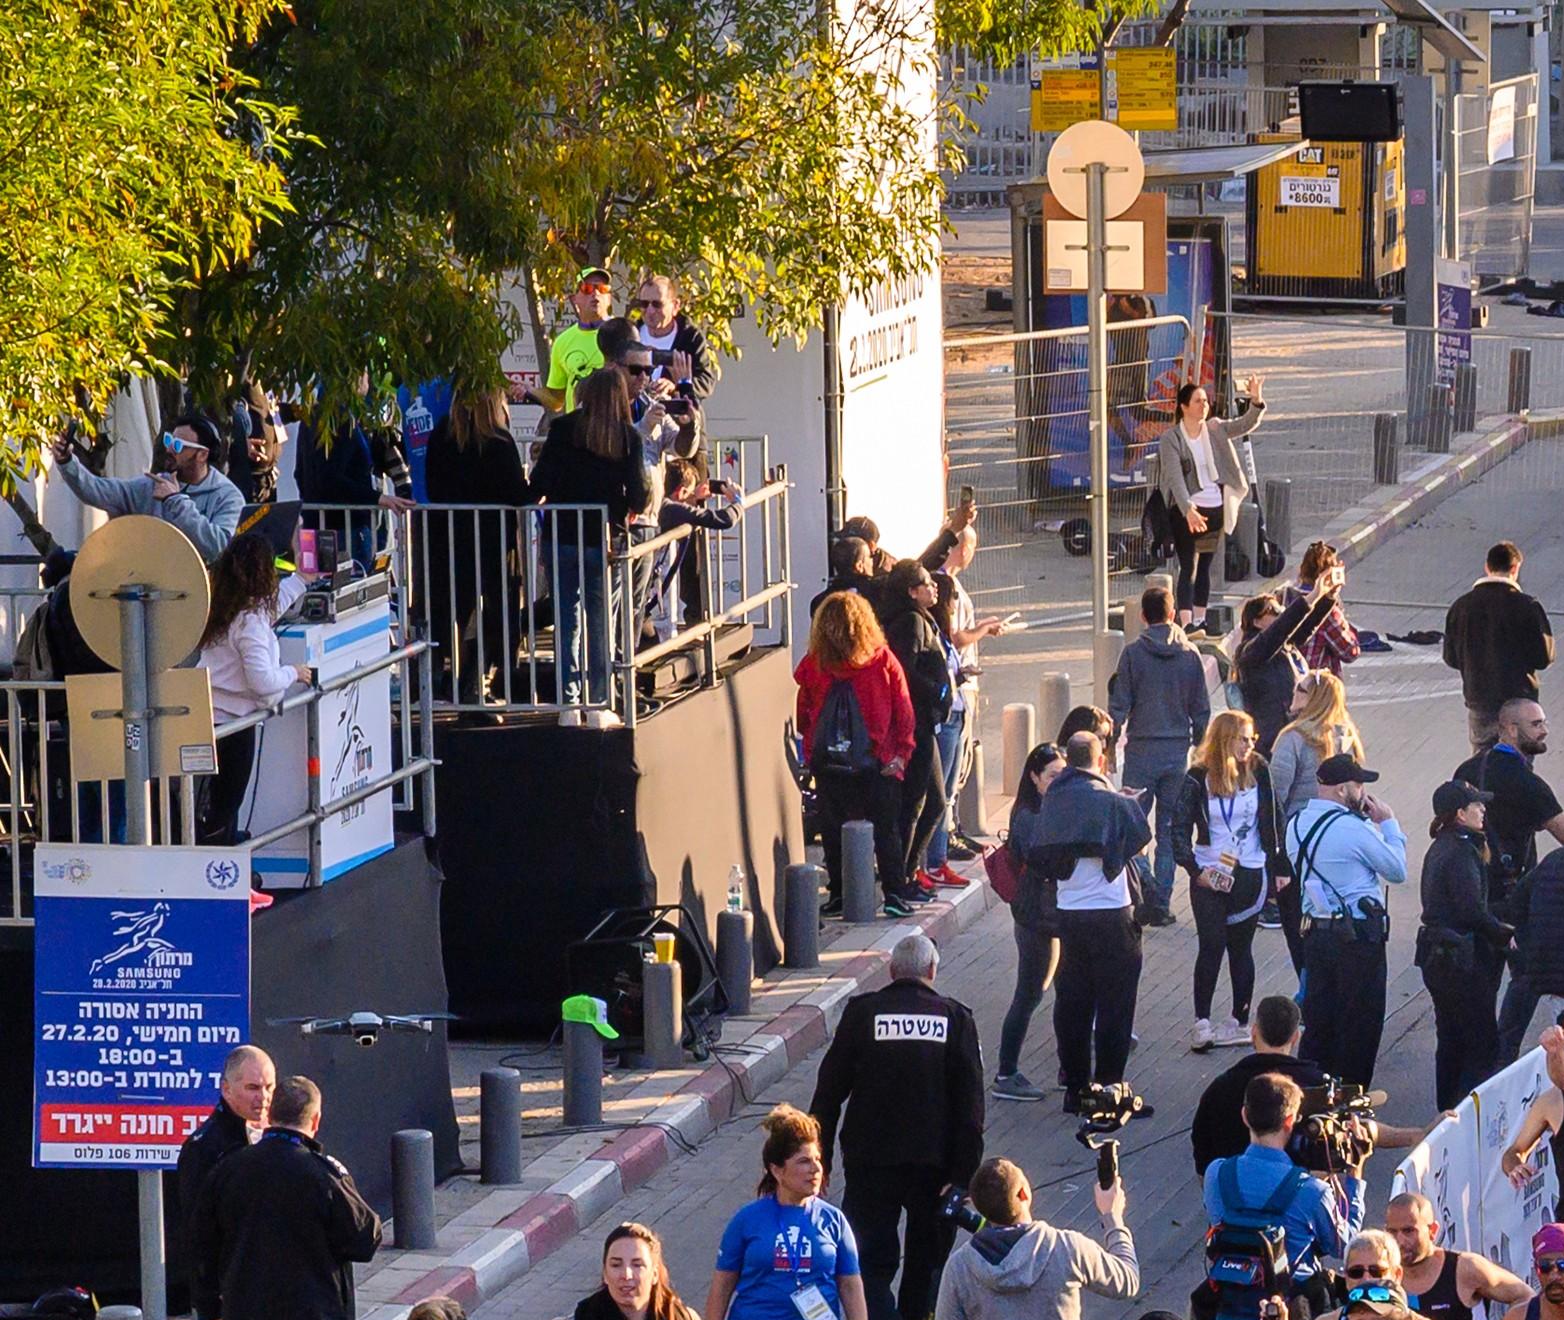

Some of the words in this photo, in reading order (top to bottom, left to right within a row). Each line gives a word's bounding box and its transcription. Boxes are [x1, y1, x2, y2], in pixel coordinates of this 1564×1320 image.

[117, 967, 181, 979] SAMSUNG
[79, 1001, 139, 1019] אסורה
[146, 1002, 203, 1020] החניה
[42, 1024, 120, 1042] 27.2.20
[197, 1026, 241, 1043] מיום
[877, 1019, 945, 1038] משטרה
[98, 1048, 183, 1066] ב-18:00
[46, 1070, 128, 1088] ב-13:00
[133, 1068, 202, 1089] למחרת
[120, 1114, 174, 1135] חונה
[74, 1147, 104, 1160] פלוס
[109, 1148, 131, 1159] 106
[135, 1148, 171, 1160] שירות
